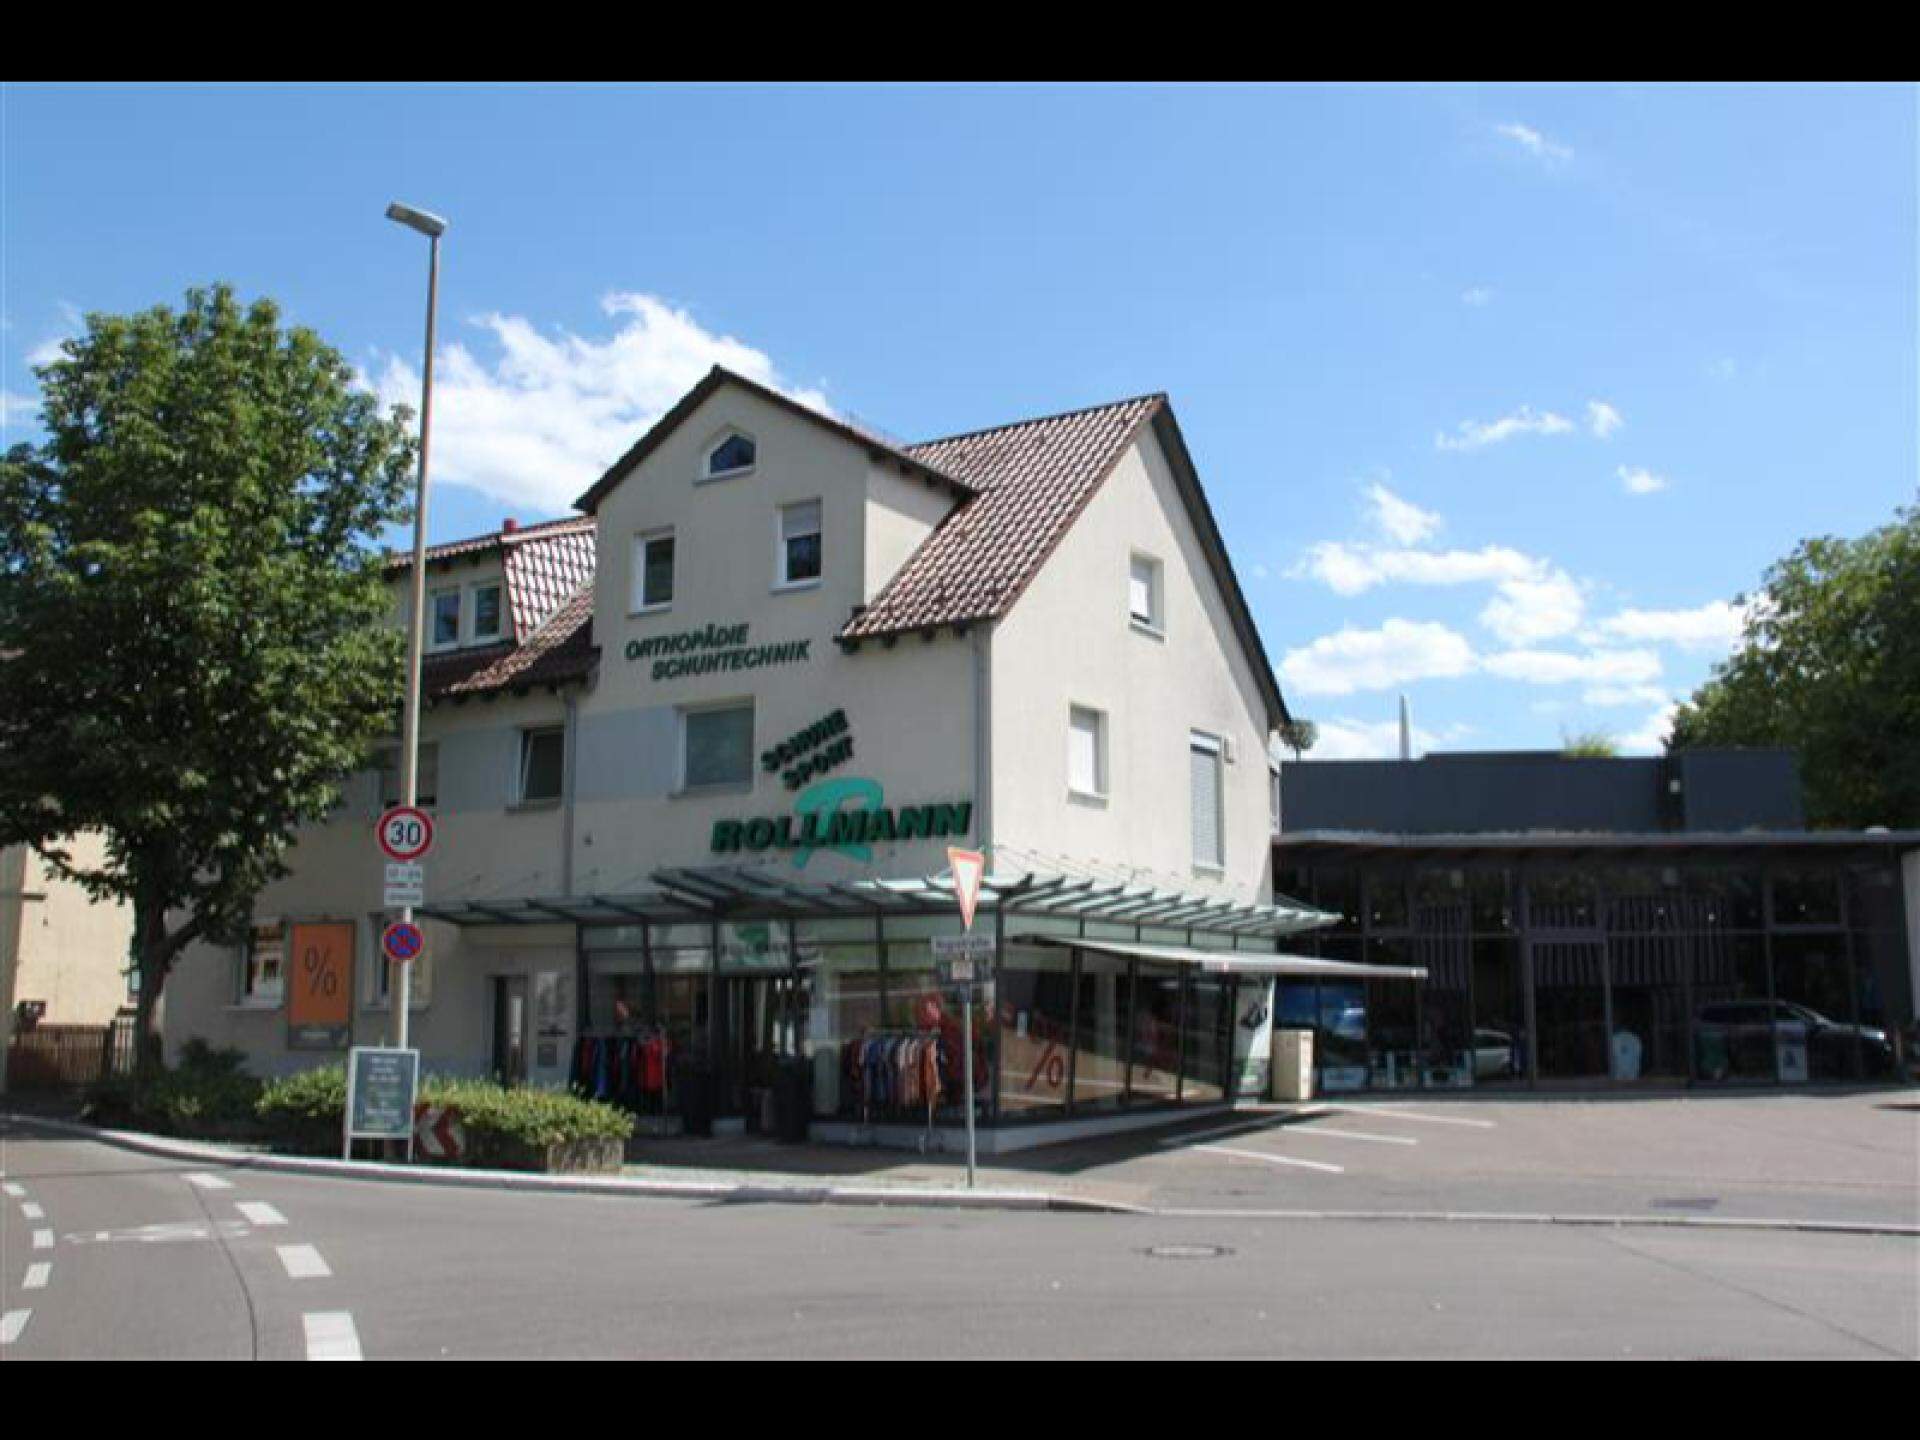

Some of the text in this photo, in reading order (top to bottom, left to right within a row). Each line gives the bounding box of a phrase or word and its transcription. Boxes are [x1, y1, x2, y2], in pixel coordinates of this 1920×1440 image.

[652, 640, 811, 680] SCHUHTECHNIK
[390, 820, 421, 846] 30
[711, 802, 972, 852] ROLLMANN
